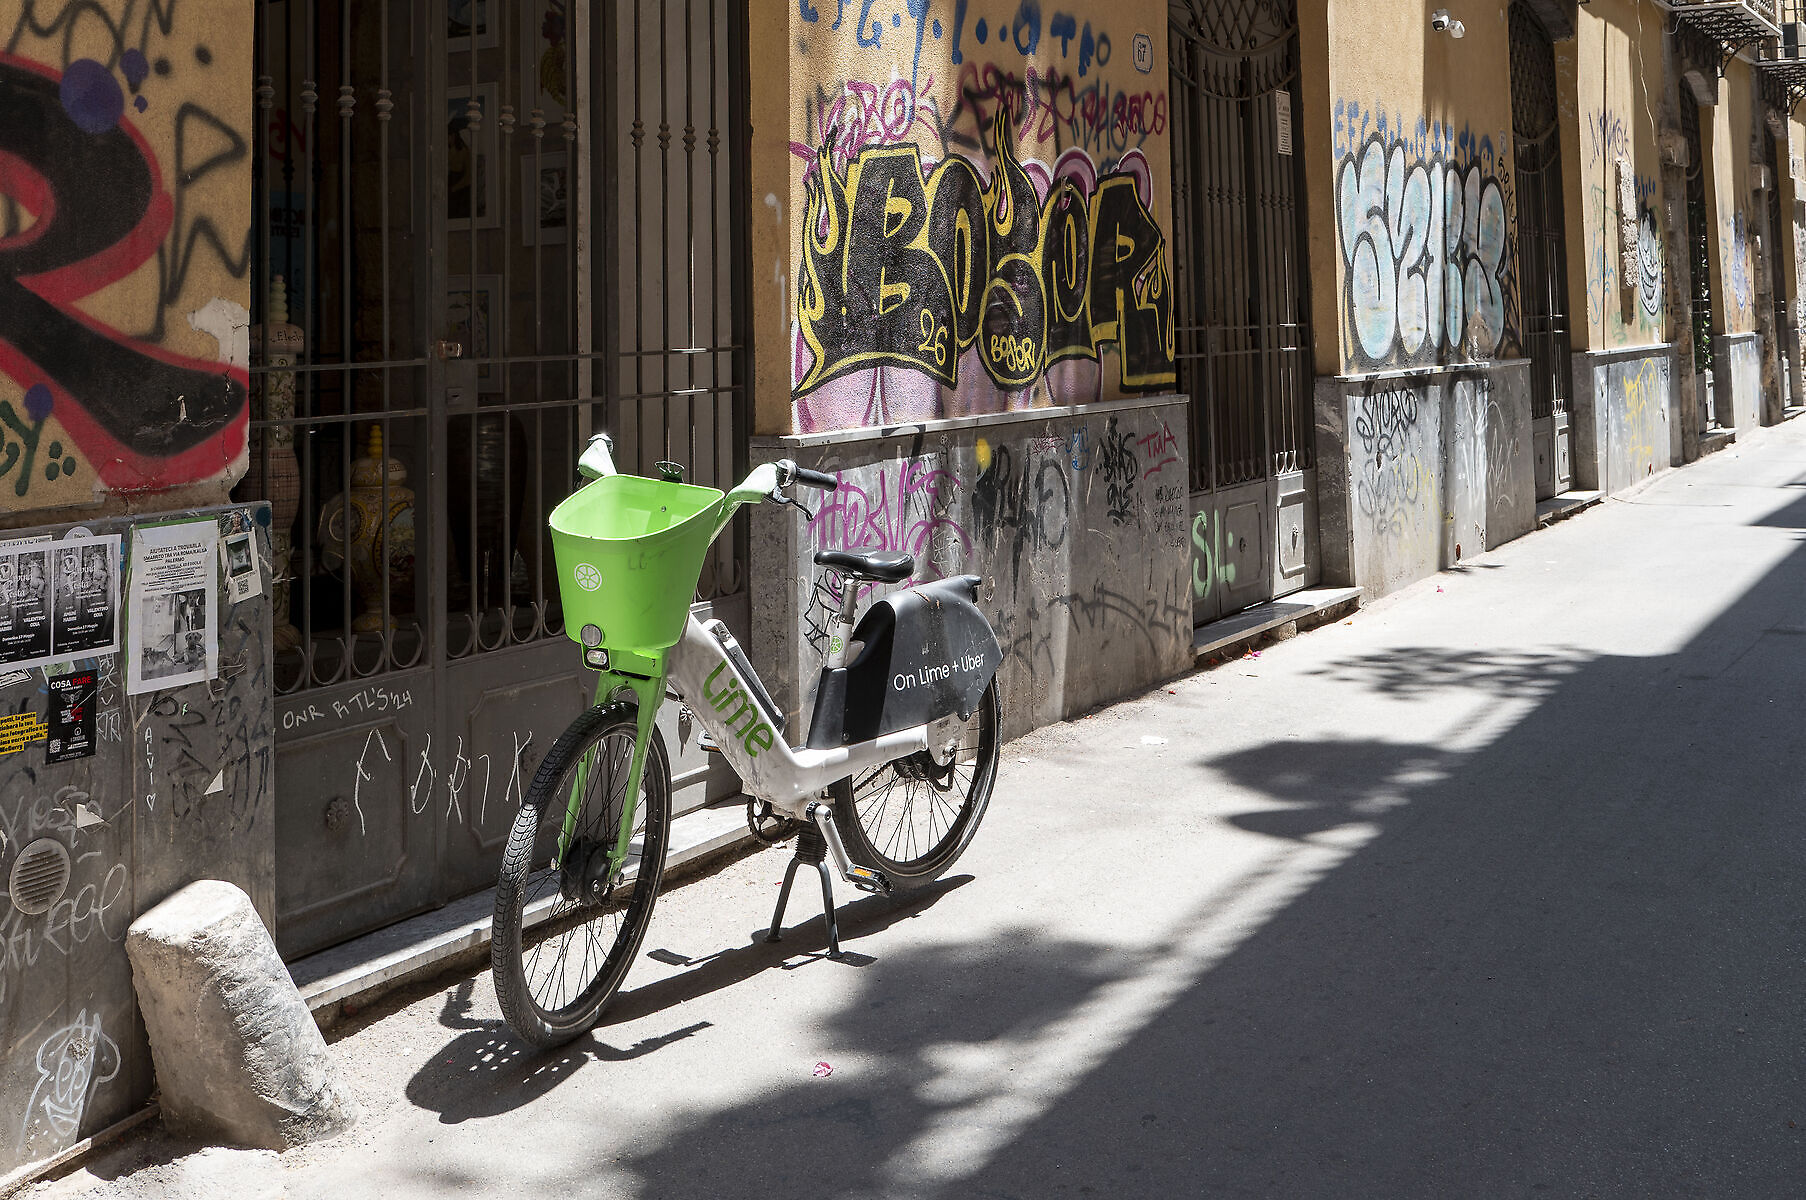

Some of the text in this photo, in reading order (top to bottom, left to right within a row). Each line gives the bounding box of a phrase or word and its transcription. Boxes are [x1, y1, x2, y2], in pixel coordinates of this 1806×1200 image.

[50, 679, 72, 690] COSA
[72, 675, 92, 686] FARE
[893, 653, 985, 692] On Lime + Uber
[703, 658, 774, 759] Lime
